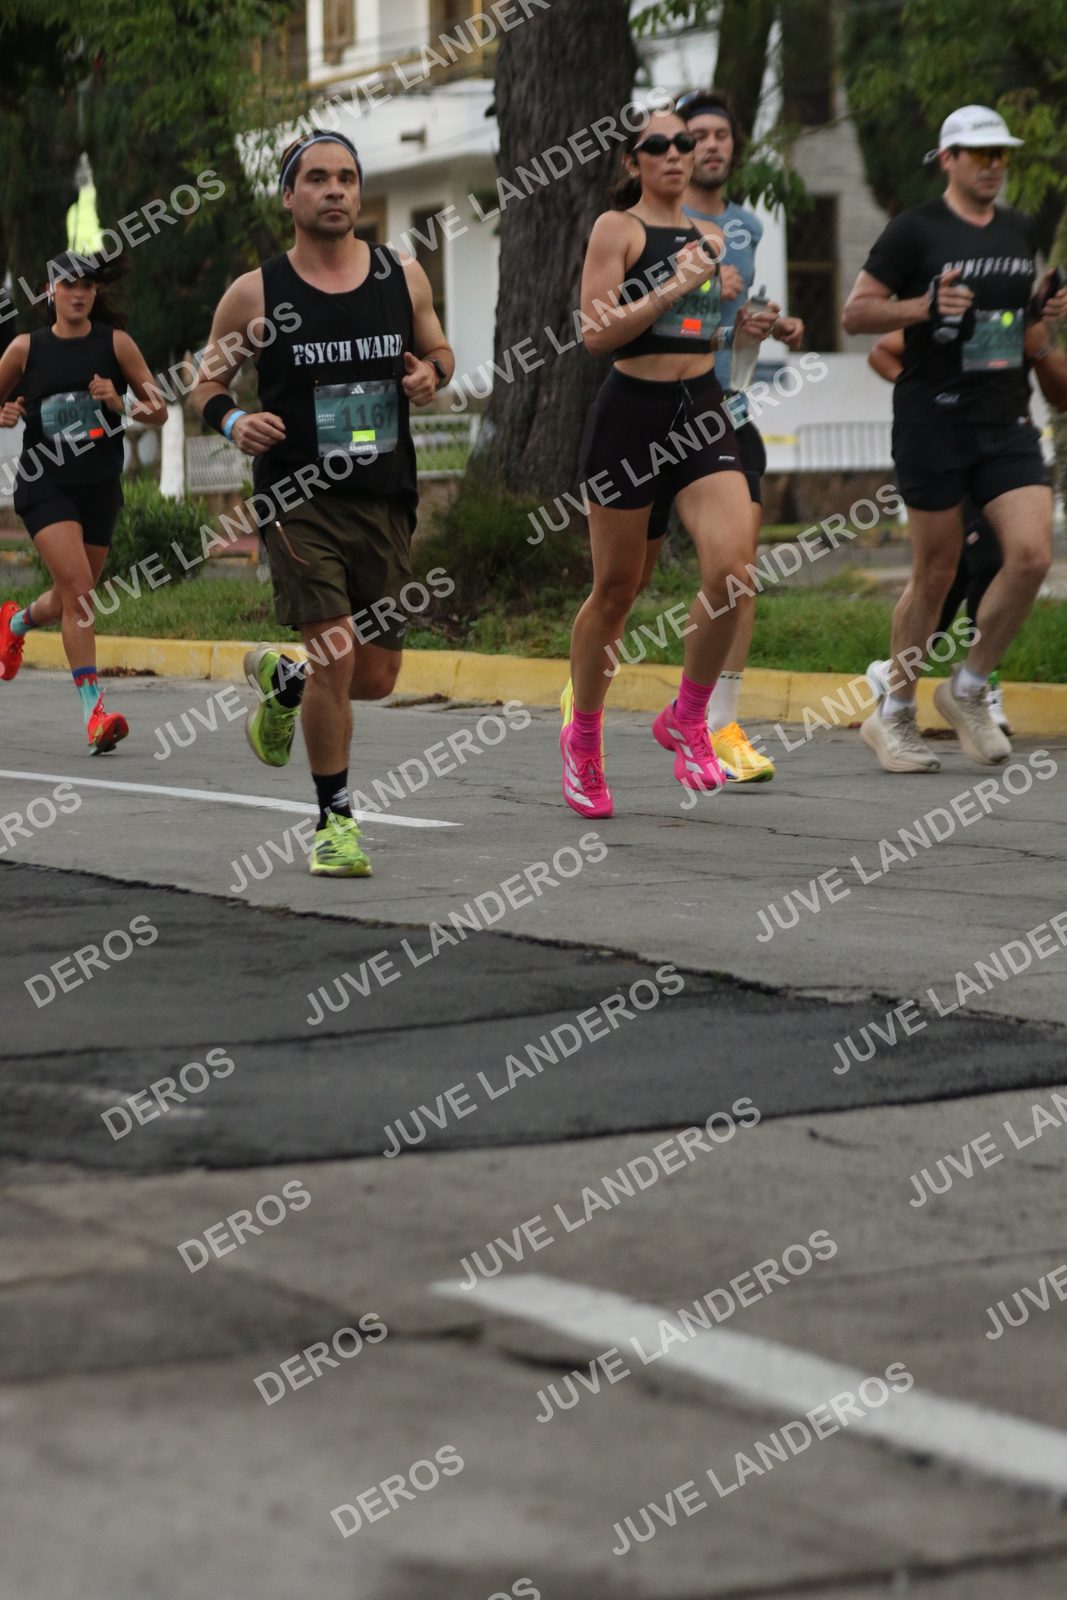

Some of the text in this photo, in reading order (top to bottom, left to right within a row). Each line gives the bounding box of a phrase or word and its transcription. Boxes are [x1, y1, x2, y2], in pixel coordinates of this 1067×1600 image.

[292, 333, 403, 366] PSYCH WARD
[341, 401, 395, 433] 1167
